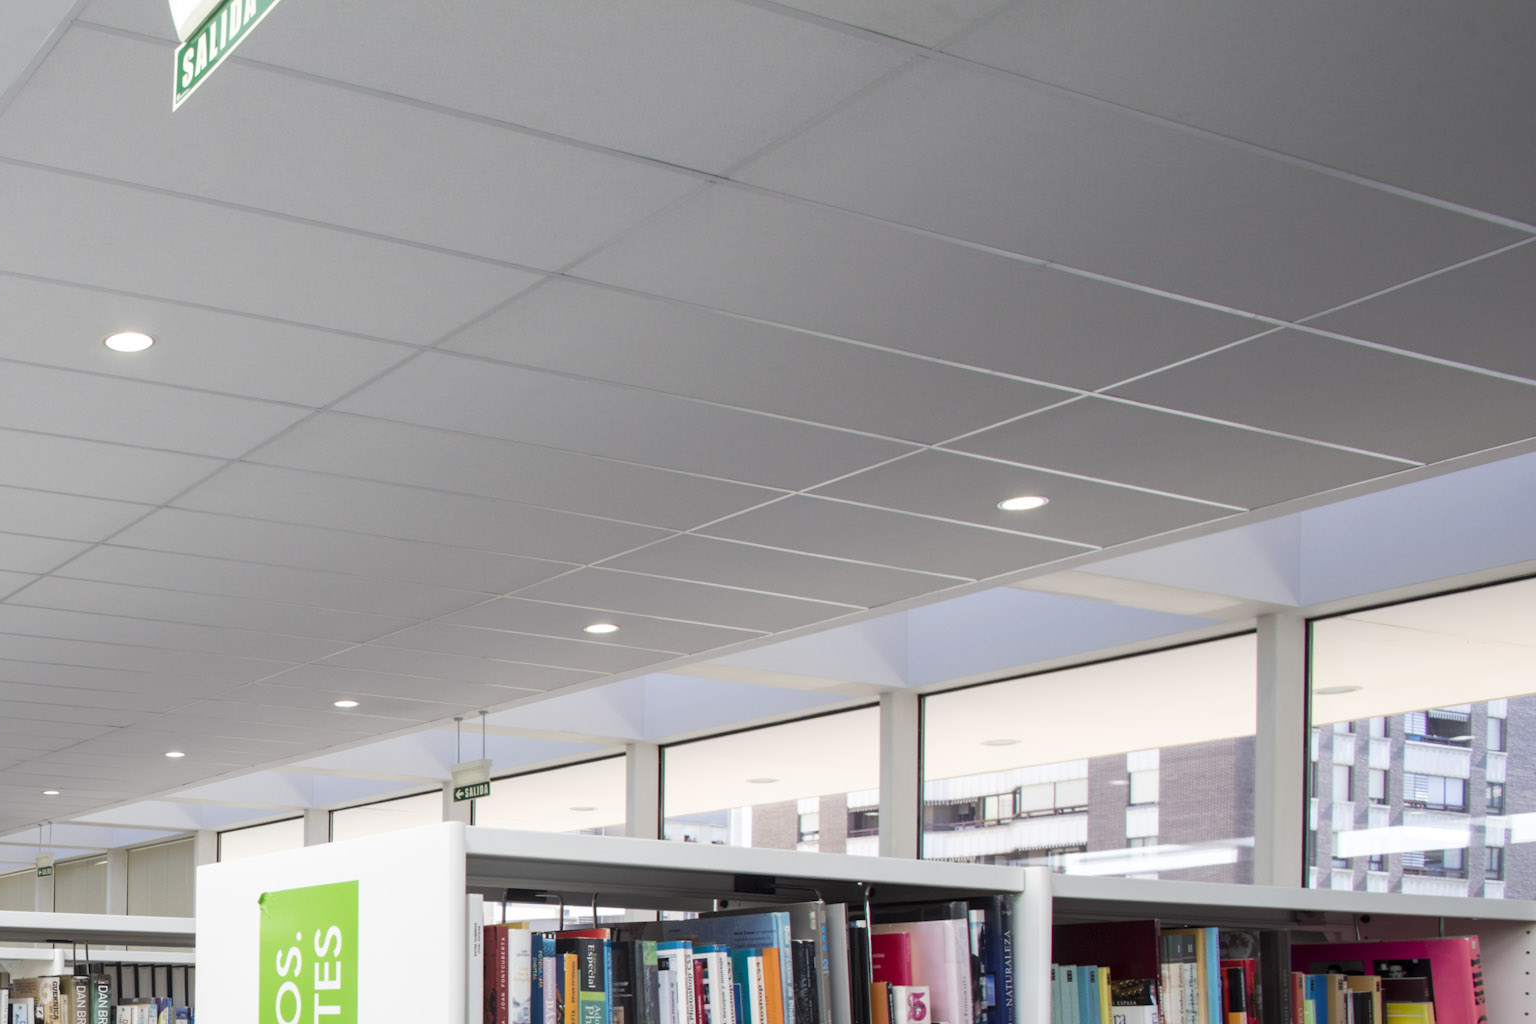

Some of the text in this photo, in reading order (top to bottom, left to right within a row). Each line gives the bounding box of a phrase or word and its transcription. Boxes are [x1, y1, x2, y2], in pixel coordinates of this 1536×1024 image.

[464, 784, 489, 798] SALIDA
[586, 944, 596, 988] Especial
[1003, 929, 1014, 1006] NATURALEZA
[1470, 954, 1485, 1006] THE
[76, 985, 86, 1008] DAN
[98, 985, 108, 1008] DAN
[686, 972, 695, 1021] Photoshop
